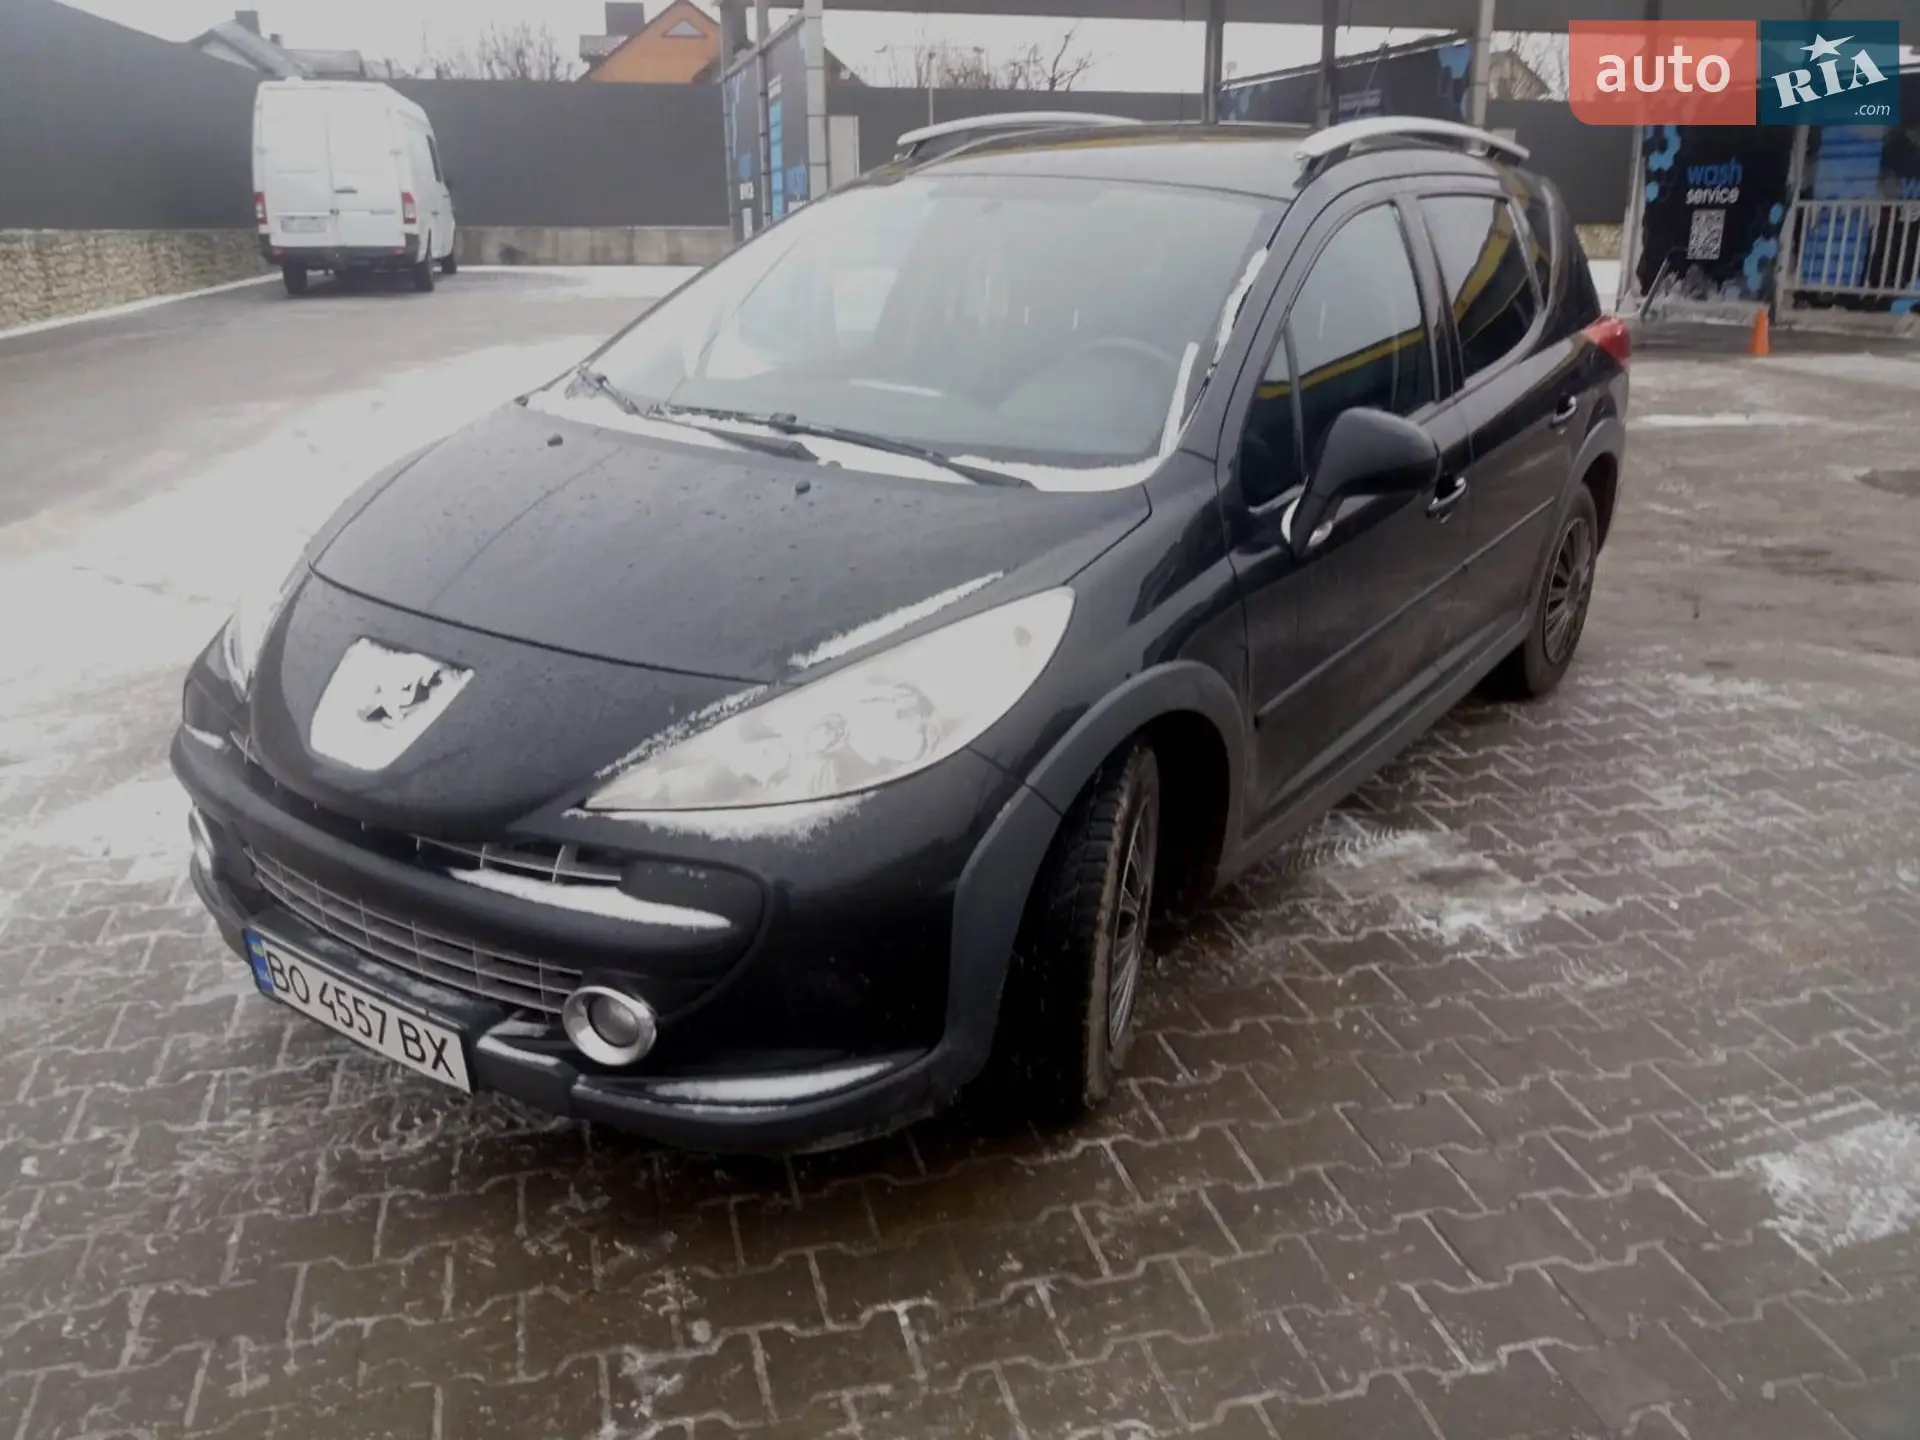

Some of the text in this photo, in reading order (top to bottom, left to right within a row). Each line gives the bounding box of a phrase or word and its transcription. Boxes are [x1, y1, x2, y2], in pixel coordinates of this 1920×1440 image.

[1686, 161, 1743, 186] wash
[1685, 186, 1740, 205] service
[266, 949, 456, 1080] BO 4557 BX
